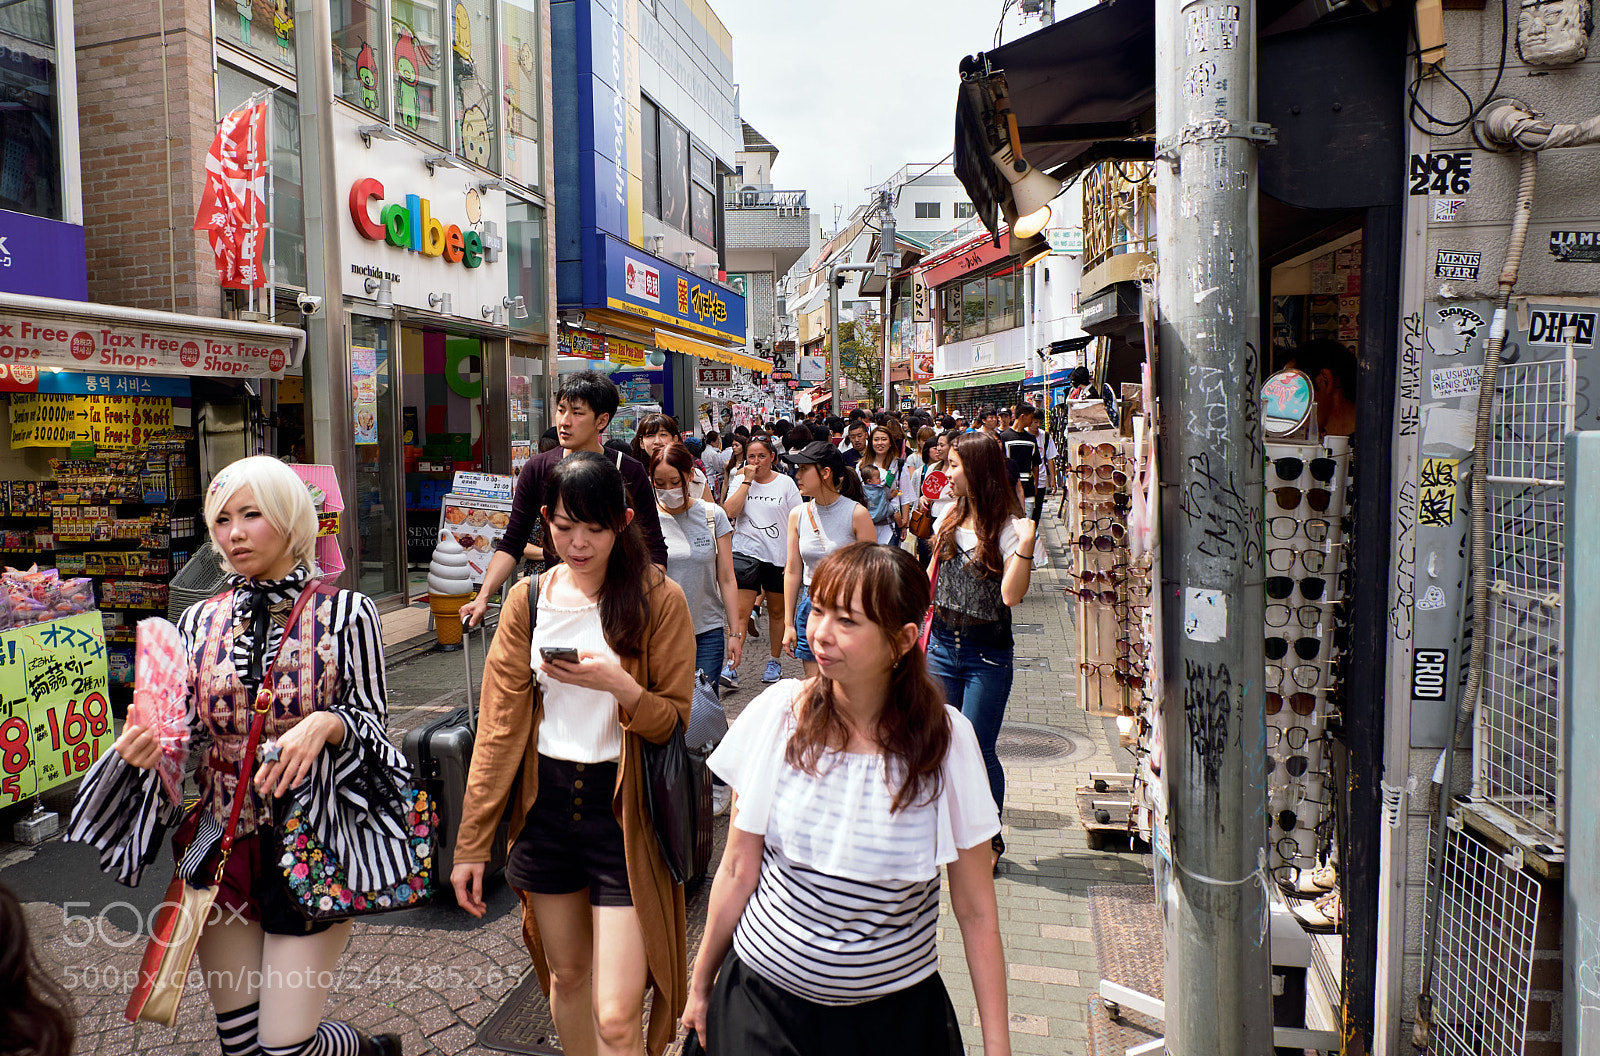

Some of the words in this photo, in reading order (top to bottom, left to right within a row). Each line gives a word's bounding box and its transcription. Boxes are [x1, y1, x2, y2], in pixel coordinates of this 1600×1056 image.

[1410, 153, 1472, 175] NOE
[1410, 173, 1470, 195] 246
[349, 177, 483, 269] Calbee
[1438, 252, 1480, 266] MENIS
[351, 263, 383, 280] mochida
[1438, 265, 1475, 279] STAR!
[915, 283, 924, 317] DONA
[21, 321, 69, 343] Free
[100, 329, 136, 348] Tax
[141, 333, 180, 353] Free
[99, 348, 148, 370] Shop
[205, 339, 234, 356] Tax
[237, 343, 270, 359] Free
[203, 356, 243, 375] Shop
[703, 369, 727, 382] 免税
[86, 375, 111, 392] 통역
[116, 377, 152, 393] 서비스
[1434, 380, 1460, 392] MENIS
[89, 406, 101, 423] Tax
[40, 623, 104, 659] オススメ
[1415, 651, 1445, 698] CROD
[71, 675, 106, 696] 2種入り
